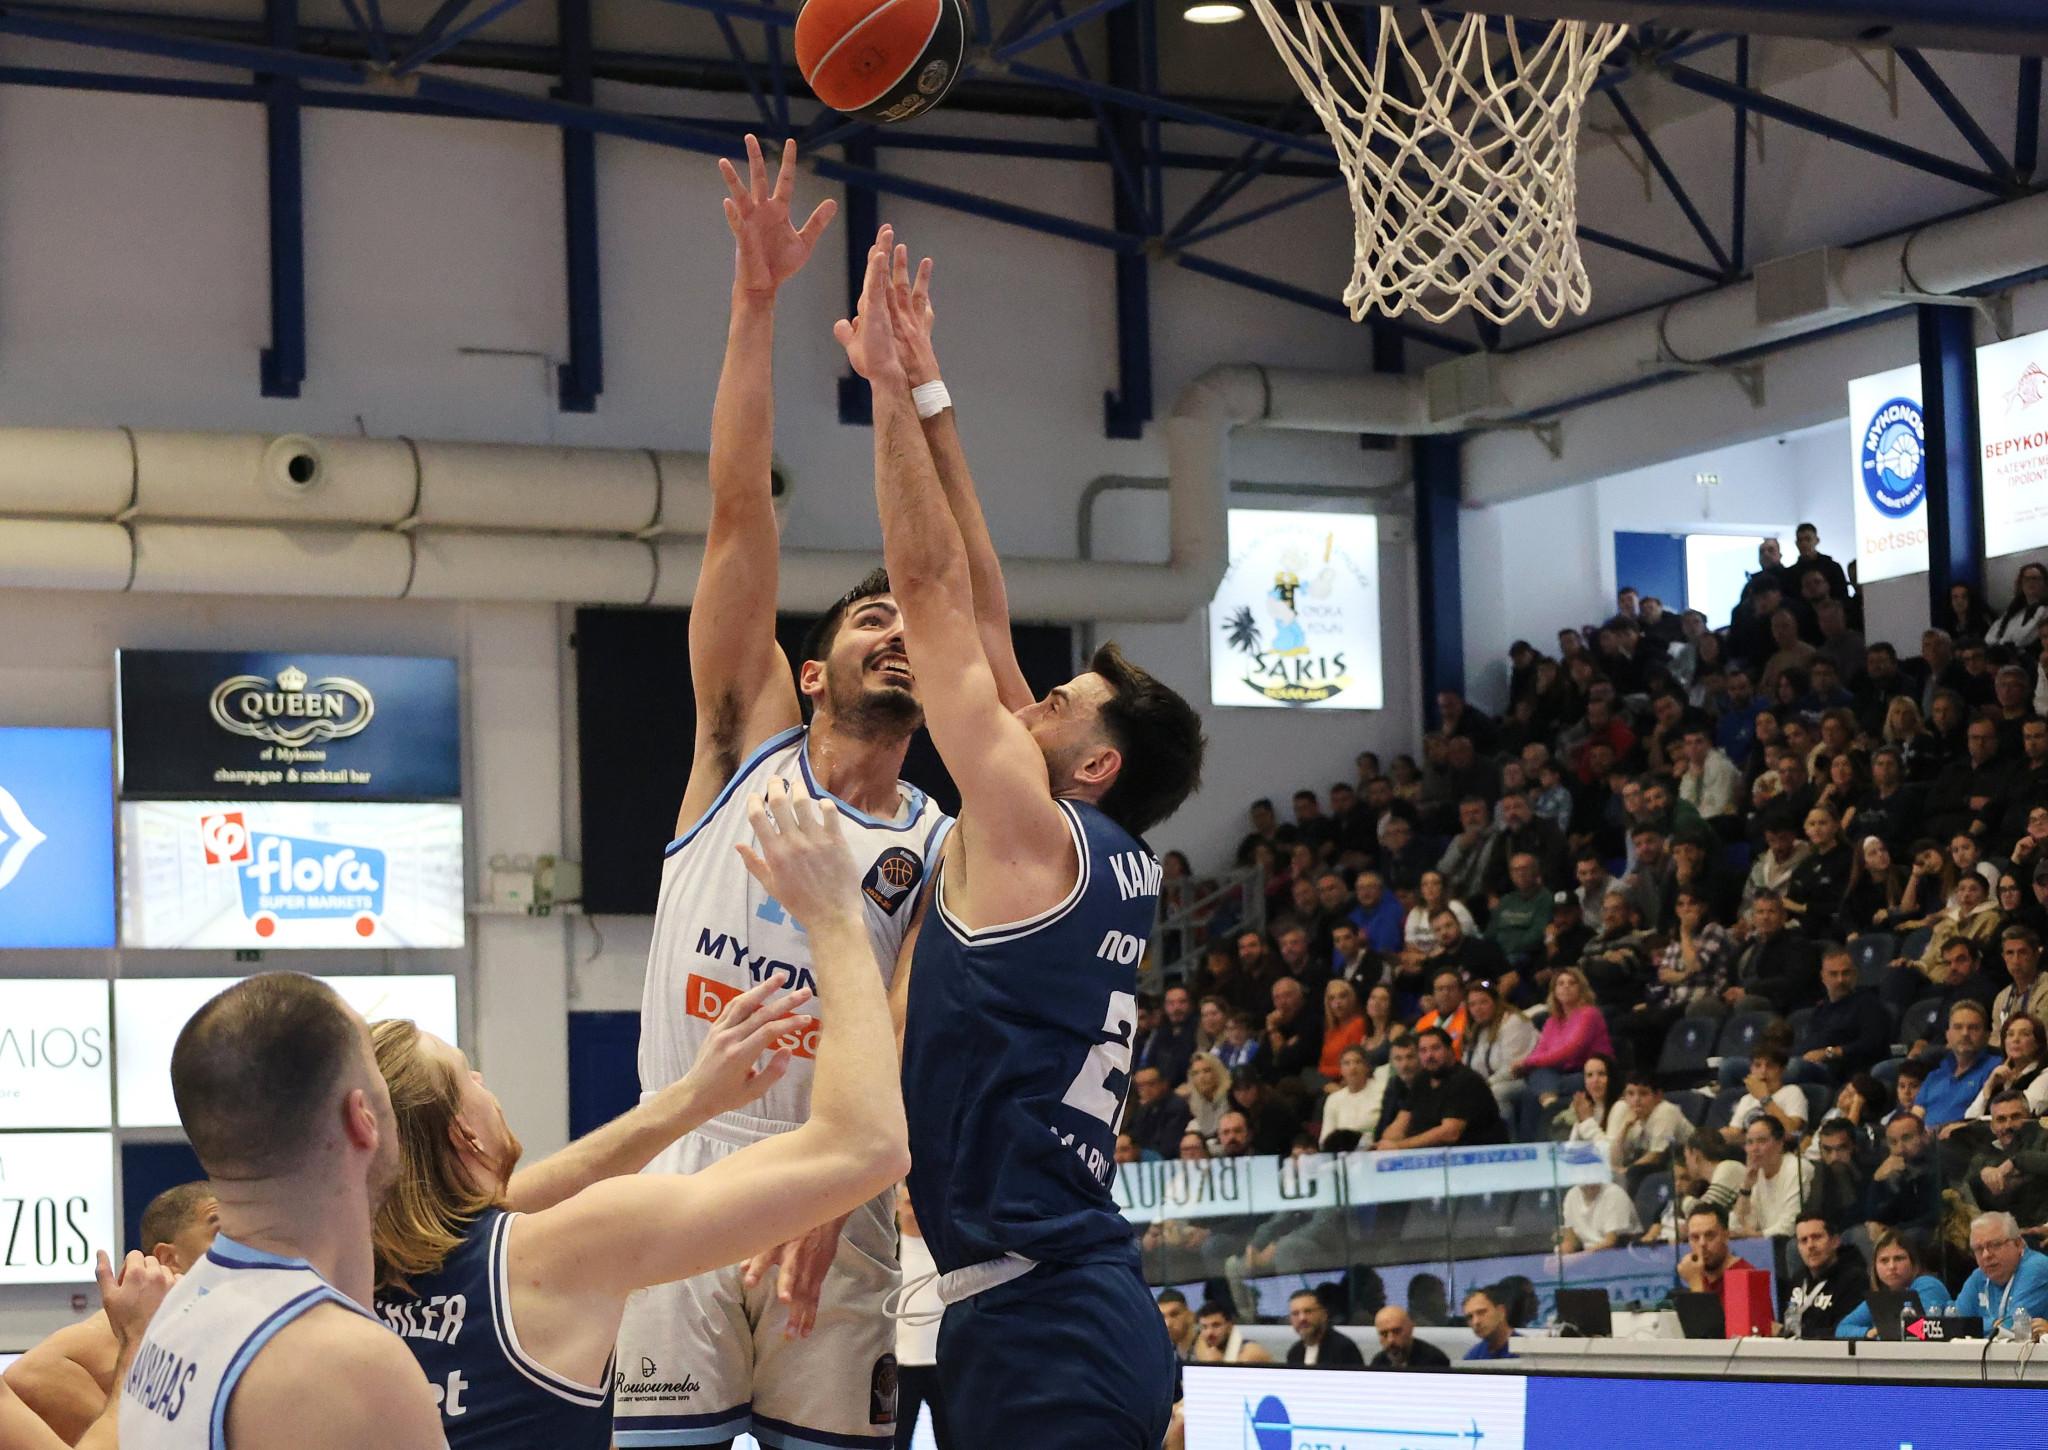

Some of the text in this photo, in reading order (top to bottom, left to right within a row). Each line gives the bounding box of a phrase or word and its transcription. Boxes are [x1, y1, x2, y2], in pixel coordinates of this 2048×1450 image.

[1866, 405, 1924, 451] MYKONOS
[1253, 652, 1347, 680] SAKIS
[241, 692, 345, 719] QUEEN
[259, 747, 327, 764] of Mykonos
[214, 767, 371, 785] champagne & cocktail bar
[246, 836, 379, 894] flora
[259, 895, 373, 910] SUPER MARKETS
[1922, 1320, 1944, 1338] POSS
[614, 1372, 700, 1394] Rousounelos
